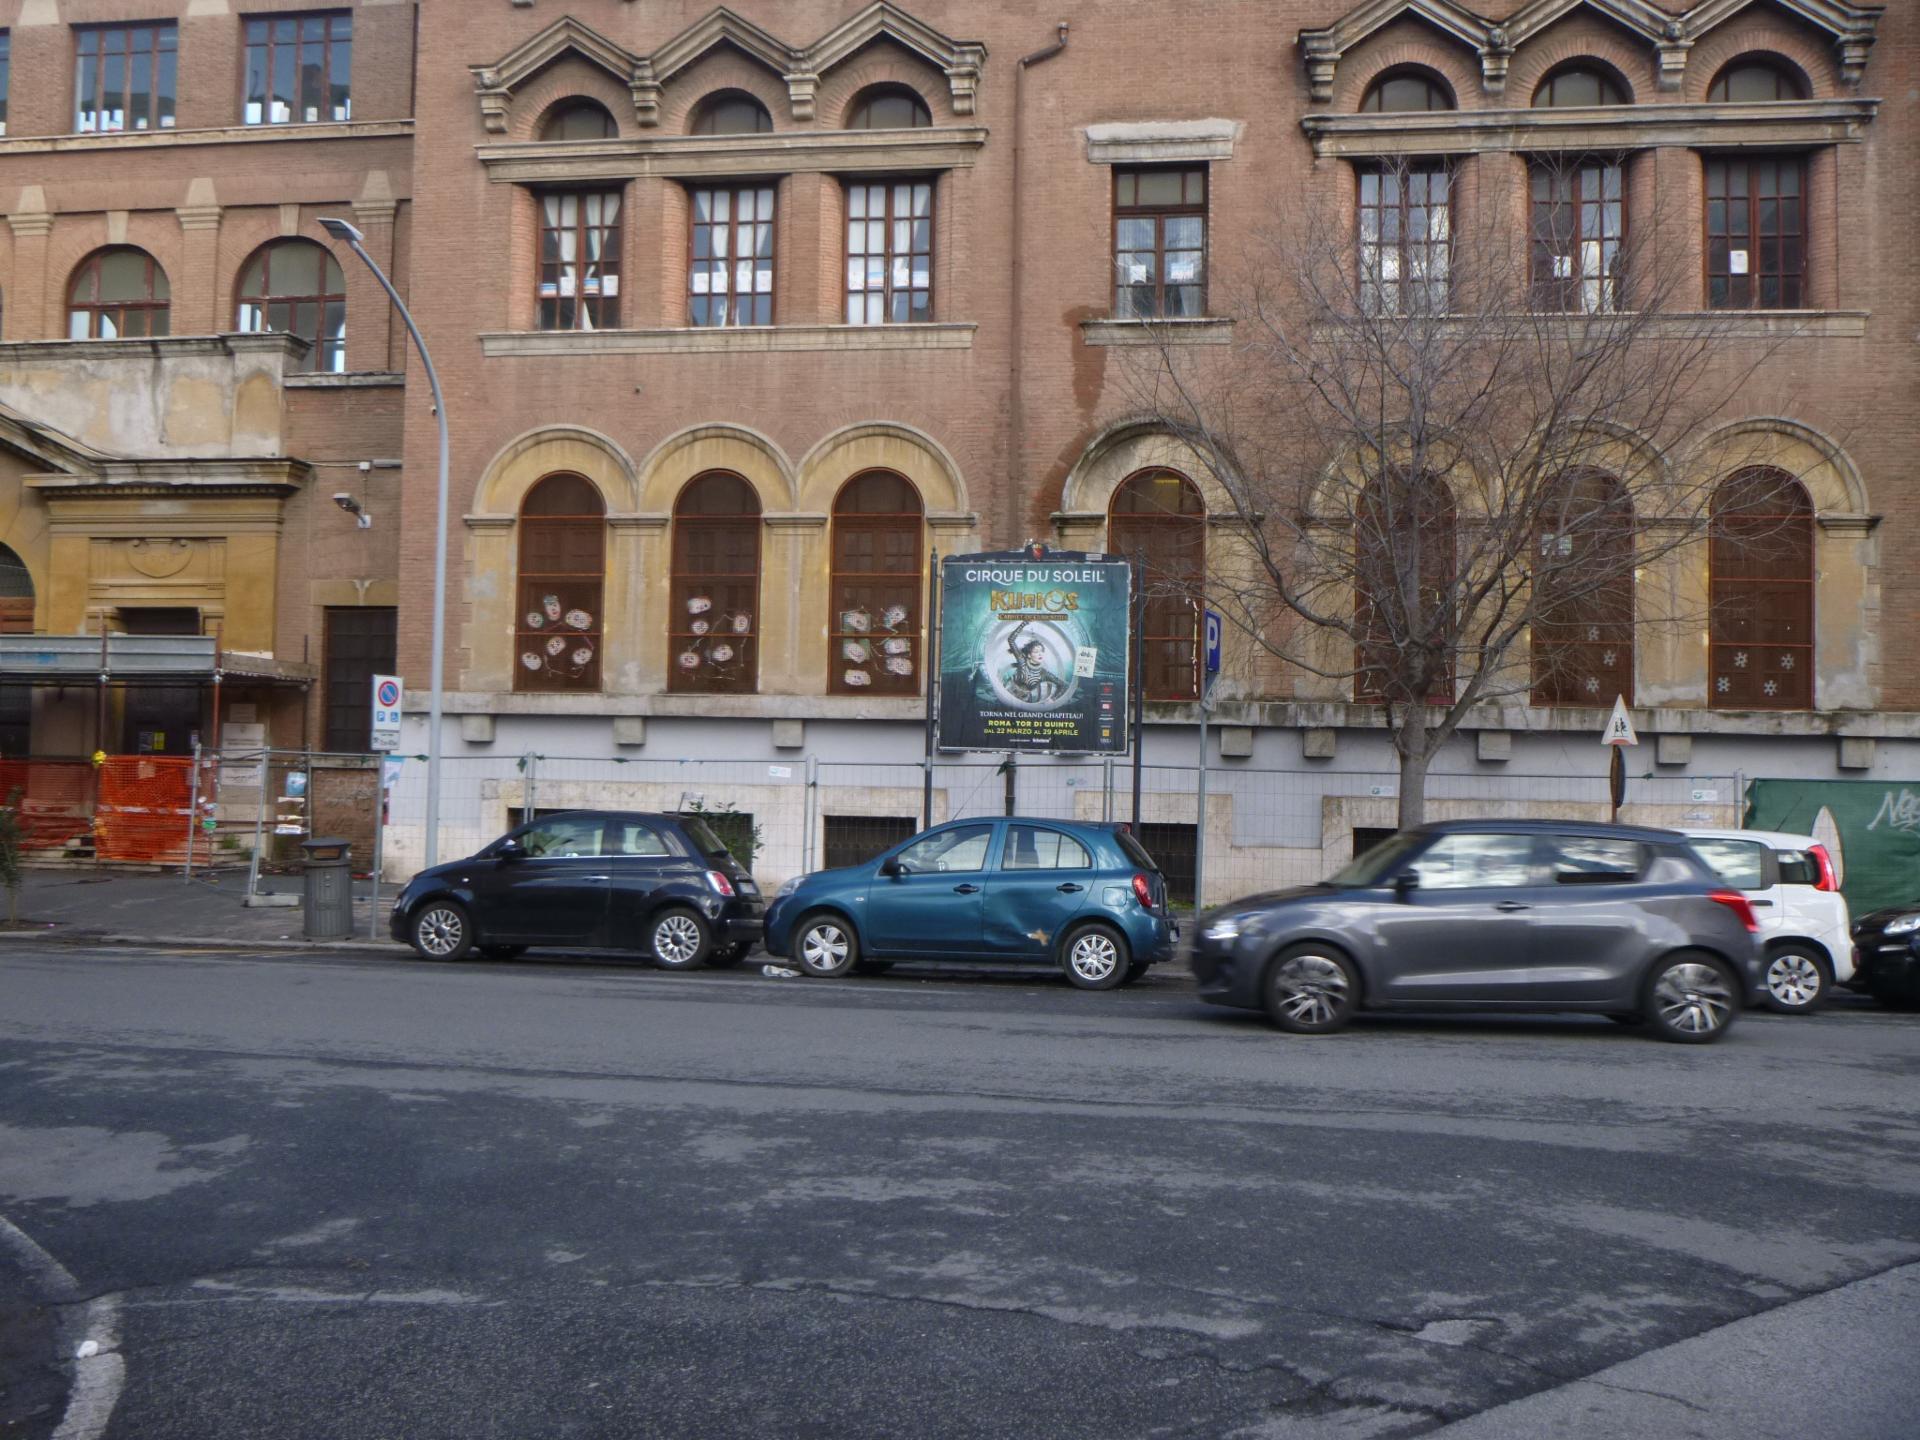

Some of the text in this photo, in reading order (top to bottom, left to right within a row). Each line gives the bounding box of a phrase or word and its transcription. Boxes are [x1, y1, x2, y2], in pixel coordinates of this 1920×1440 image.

[966, 570, 1105, 586] CIRQUE DU SOLEIL
[1206, 617, 1219, 666] P
